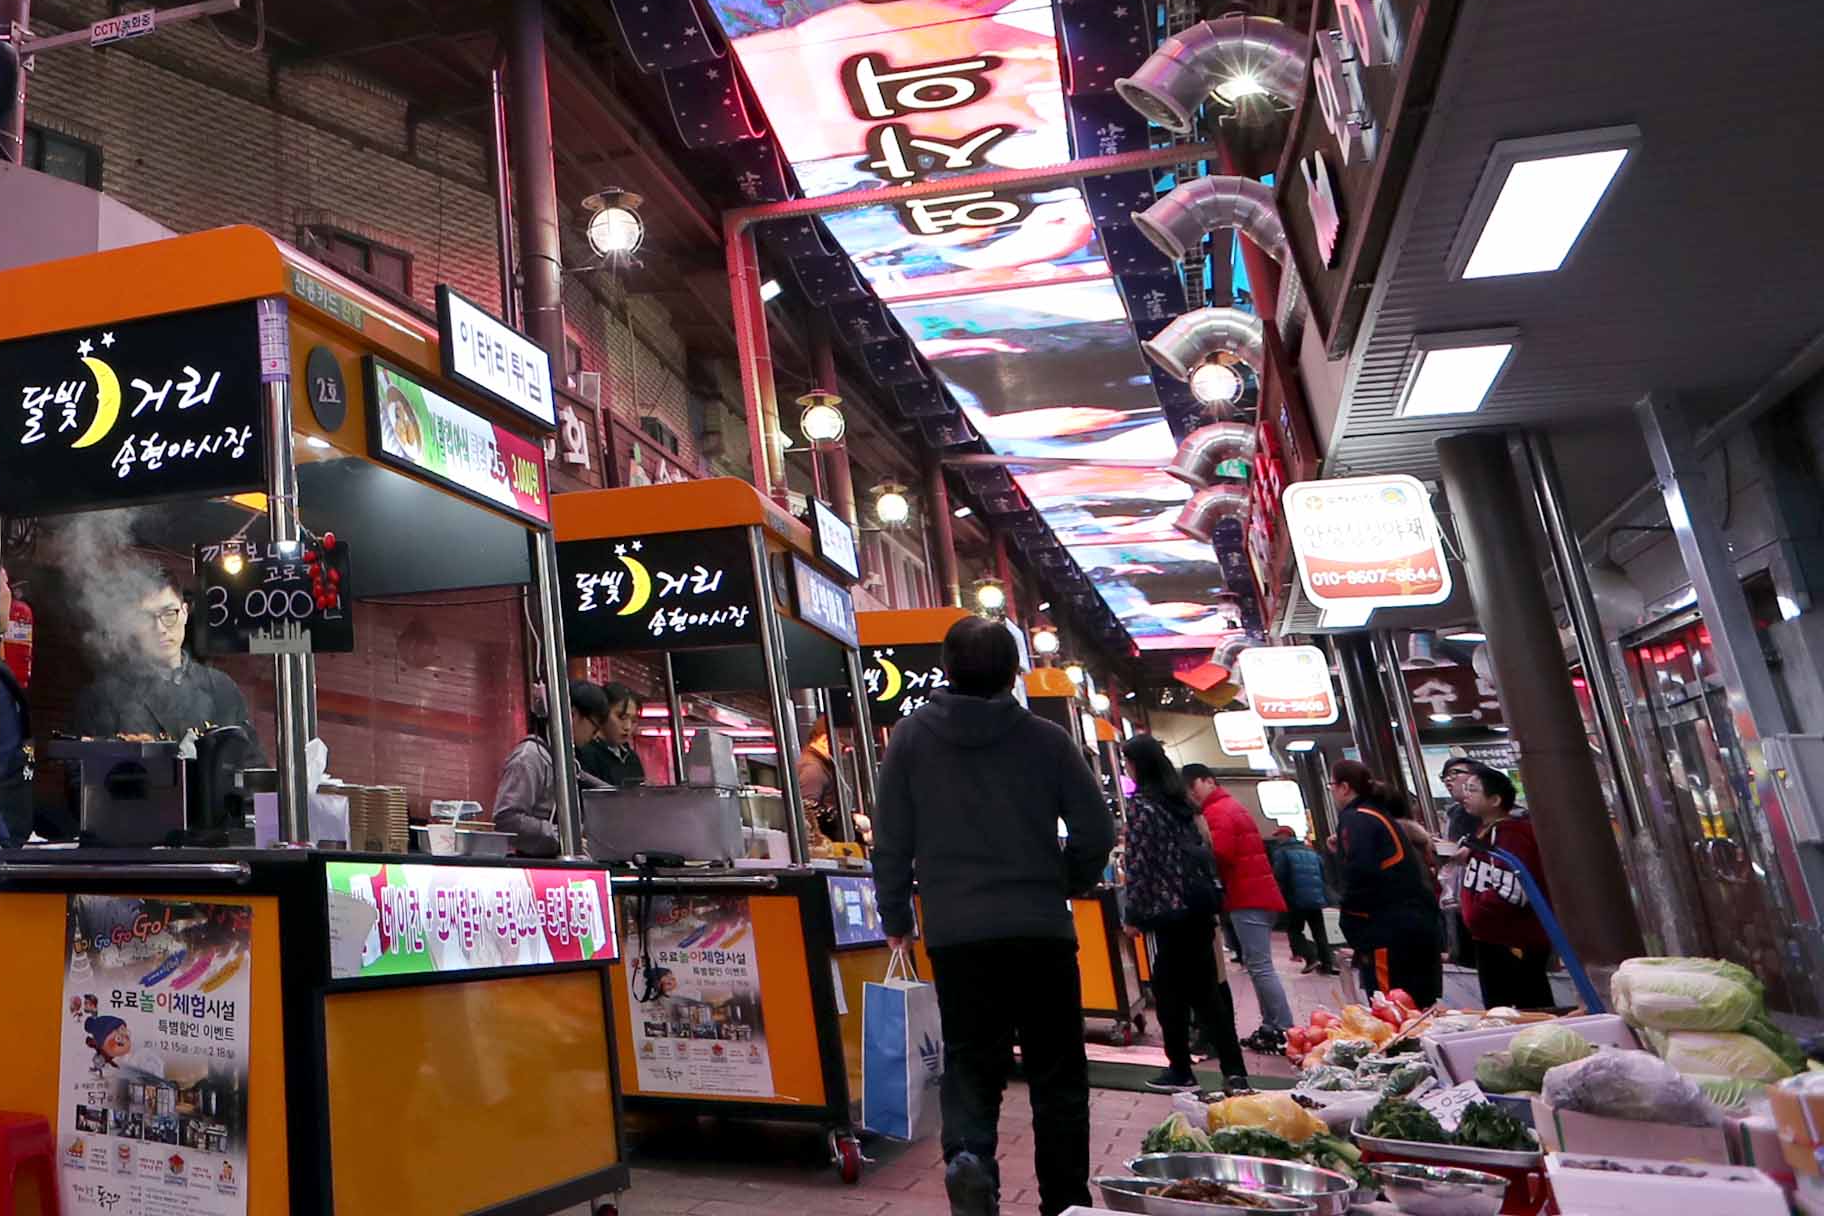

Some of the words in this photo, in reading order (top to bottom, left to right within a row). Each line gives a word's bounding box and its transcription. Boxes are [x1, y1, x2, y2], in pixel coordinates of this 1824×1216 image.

[459, 320, 543, 404] 이태리튀김
[20, 381, 87, 445] 달빛
[130, 365, 222, 418] 거리
[111, 424, 253, 478] 송현야시장
[575, 570, 625, 612] 달빛
[656, 564, 723, 598] 거리
[647, 605, 749, 636] 송현야시장
[203, 1023, 236, 1041] 이벤트
